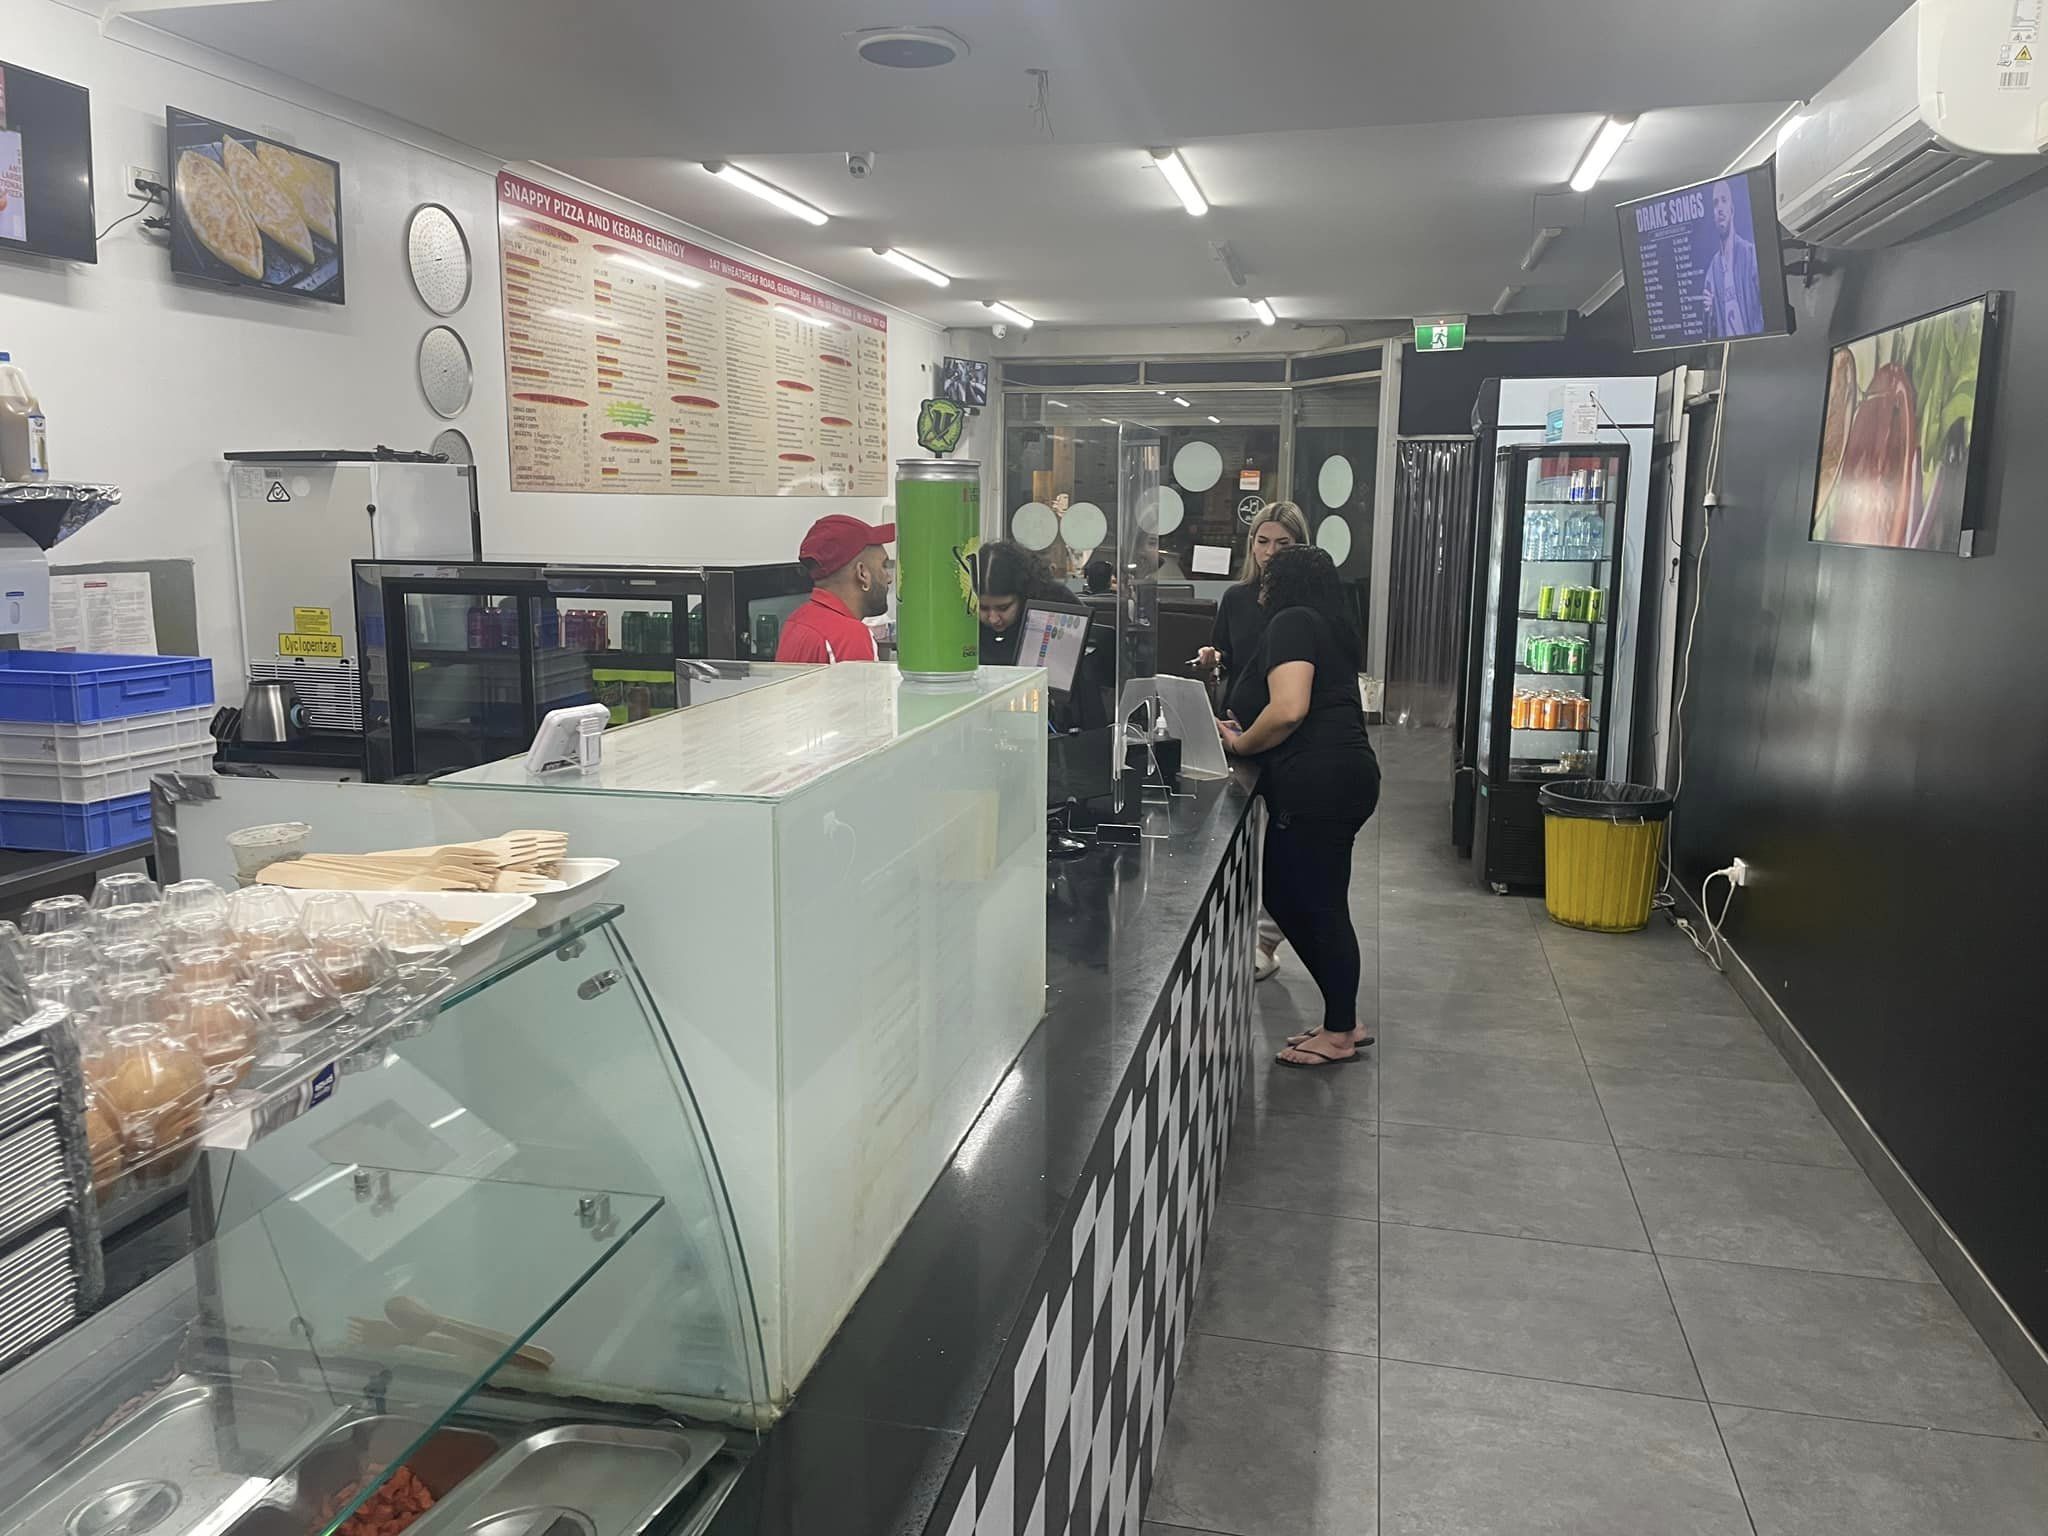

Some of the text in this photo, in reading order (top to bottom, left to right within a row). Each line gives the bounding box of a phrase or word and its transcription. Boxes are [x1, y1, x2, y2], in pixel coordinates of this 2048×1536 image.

[503, 180, 551, 212] SNAPPY
[554, 199, 585, 224] PIZZA
[587, 212, 610, 232] AND
[612, 219, 643, 244] KEBAB
[645, 233, 685, 258] GLENROY
[1636, 192, 1704, 233] DRAKE SONGS
[709, 258, 720, 272] 147
[720, 262, 759, 285] WHEATSHEAF
[285, 635, 337, 654] Cyclopentane
